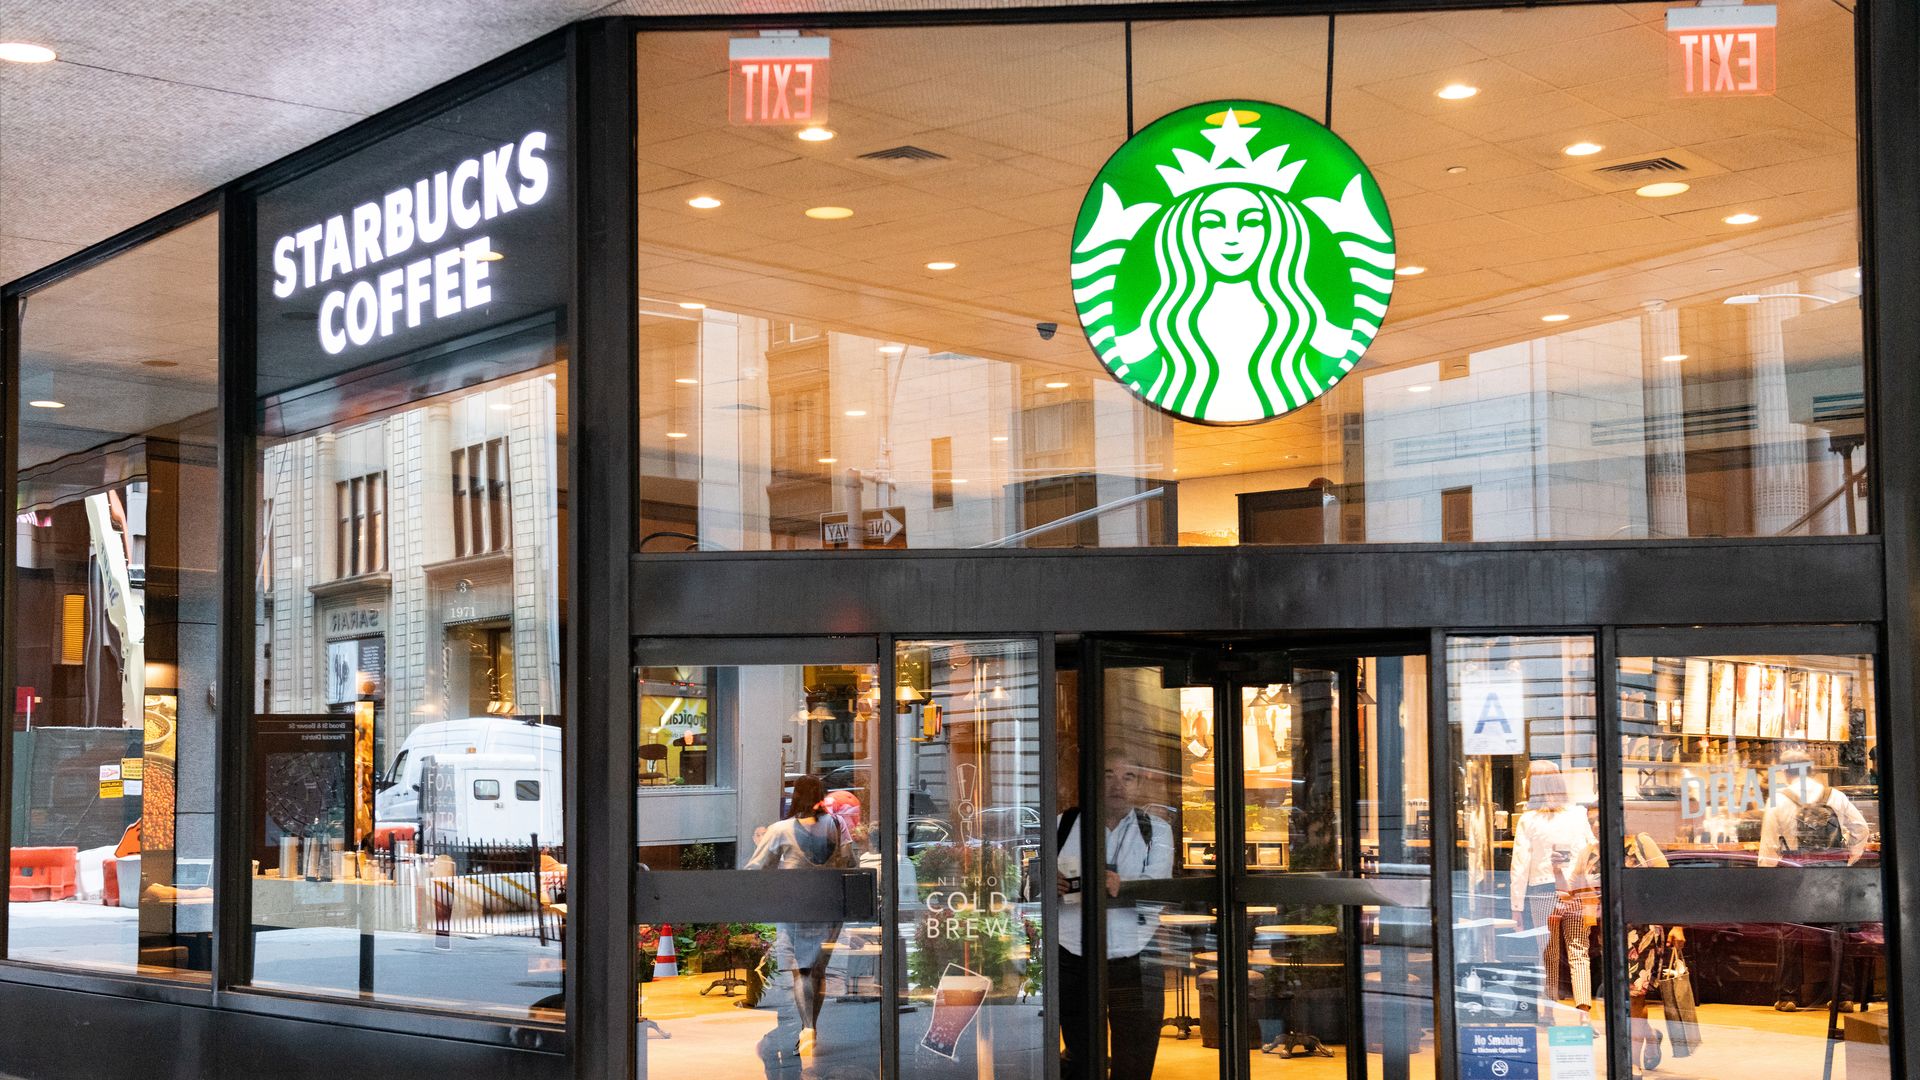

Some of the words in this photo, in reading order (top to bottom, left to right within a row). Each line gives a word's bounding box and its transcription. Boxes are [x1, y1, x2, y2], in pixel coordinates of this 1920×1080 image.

[273, 131, 549, 298] STARBUCKS
[319, 236, 492, 354] COFFEE
[450, 606, 475, 618] 1971
[1474, 692, 1512, 734] A
[1680, 760, 1815, 820] DRAFT
[938, 876, 998, 887] NITRO
[926, 891, 1008, 913] COLD
[927, 918, 1009, 939] BREW
[1474, 1034, 1487, 1046] No
[1487, 1034, 1524, 1047] Smoking
